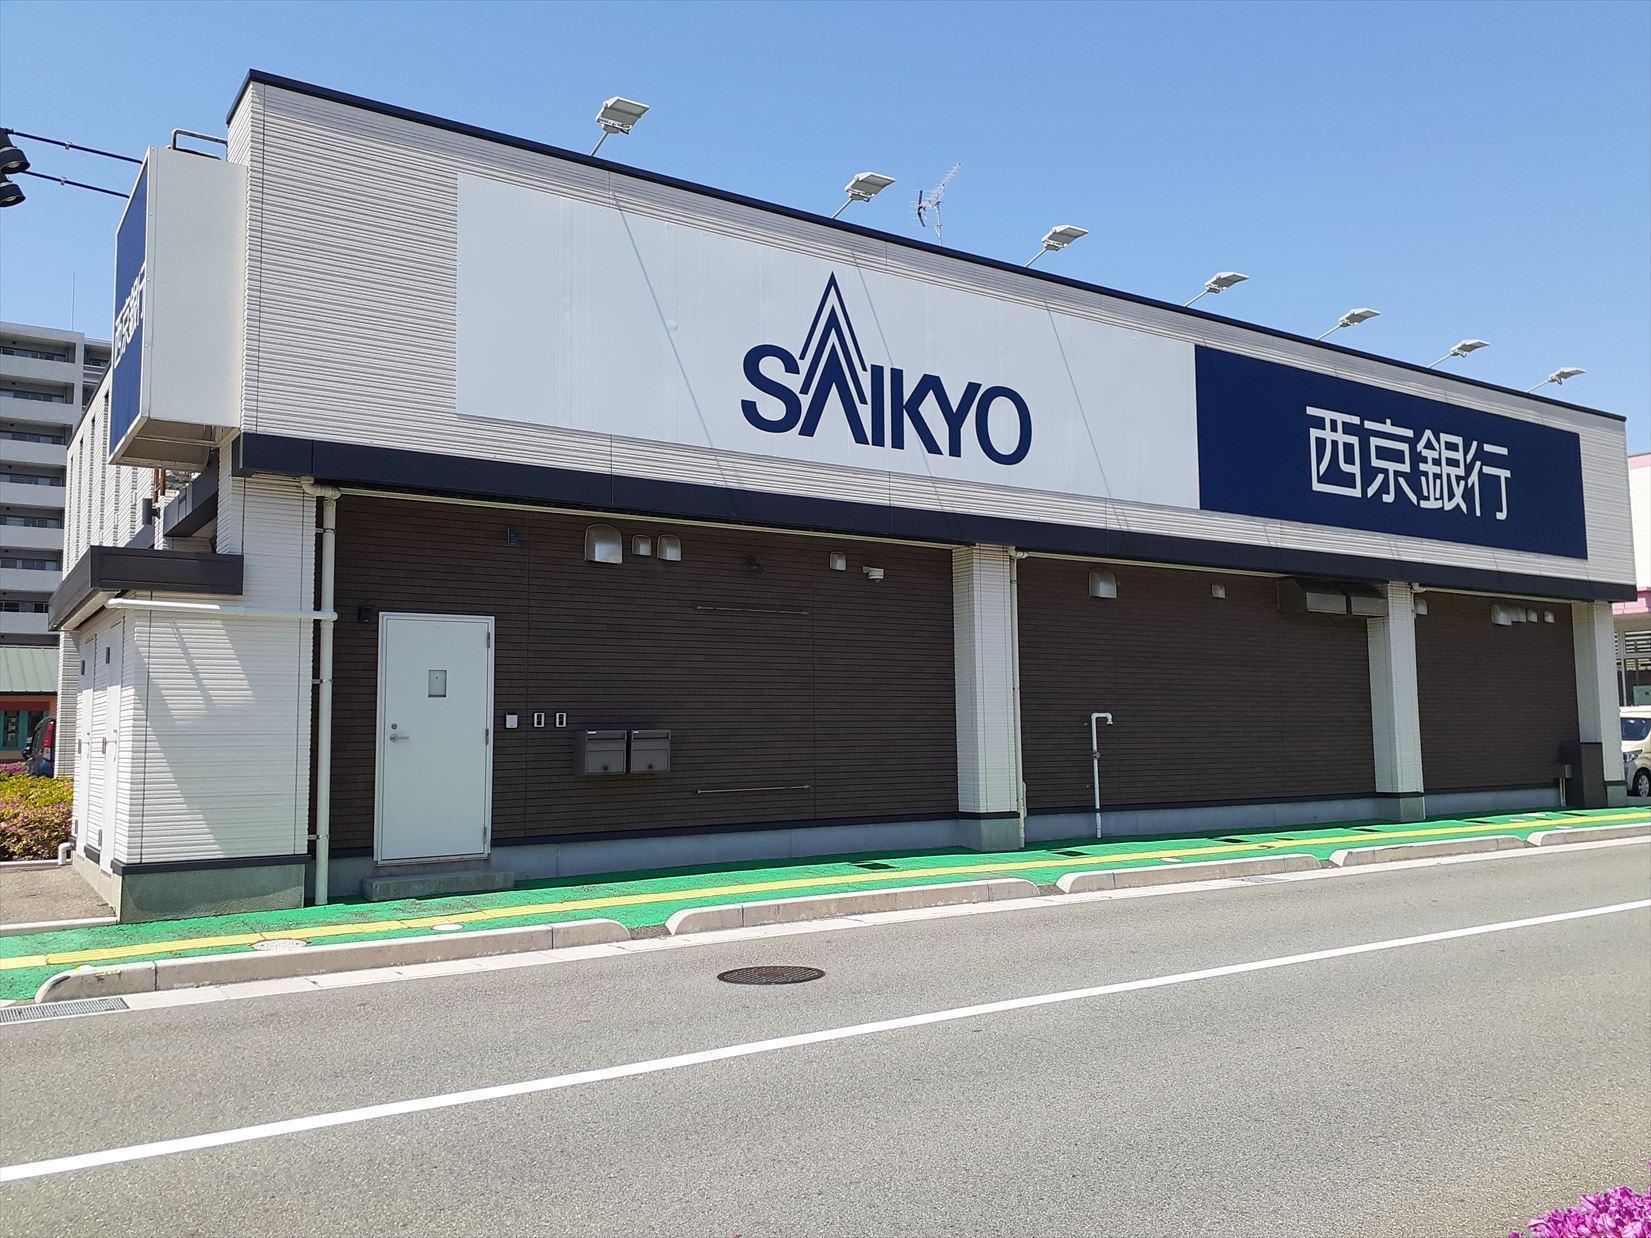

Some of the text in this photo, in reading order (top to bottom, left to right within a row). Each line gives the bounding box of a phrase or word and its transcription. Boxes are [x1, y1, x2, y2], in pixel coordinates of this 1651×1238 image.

[741, 271, 1032, 466] SAIKYO
[1306, 405, 1511, 520] 西京銀行
